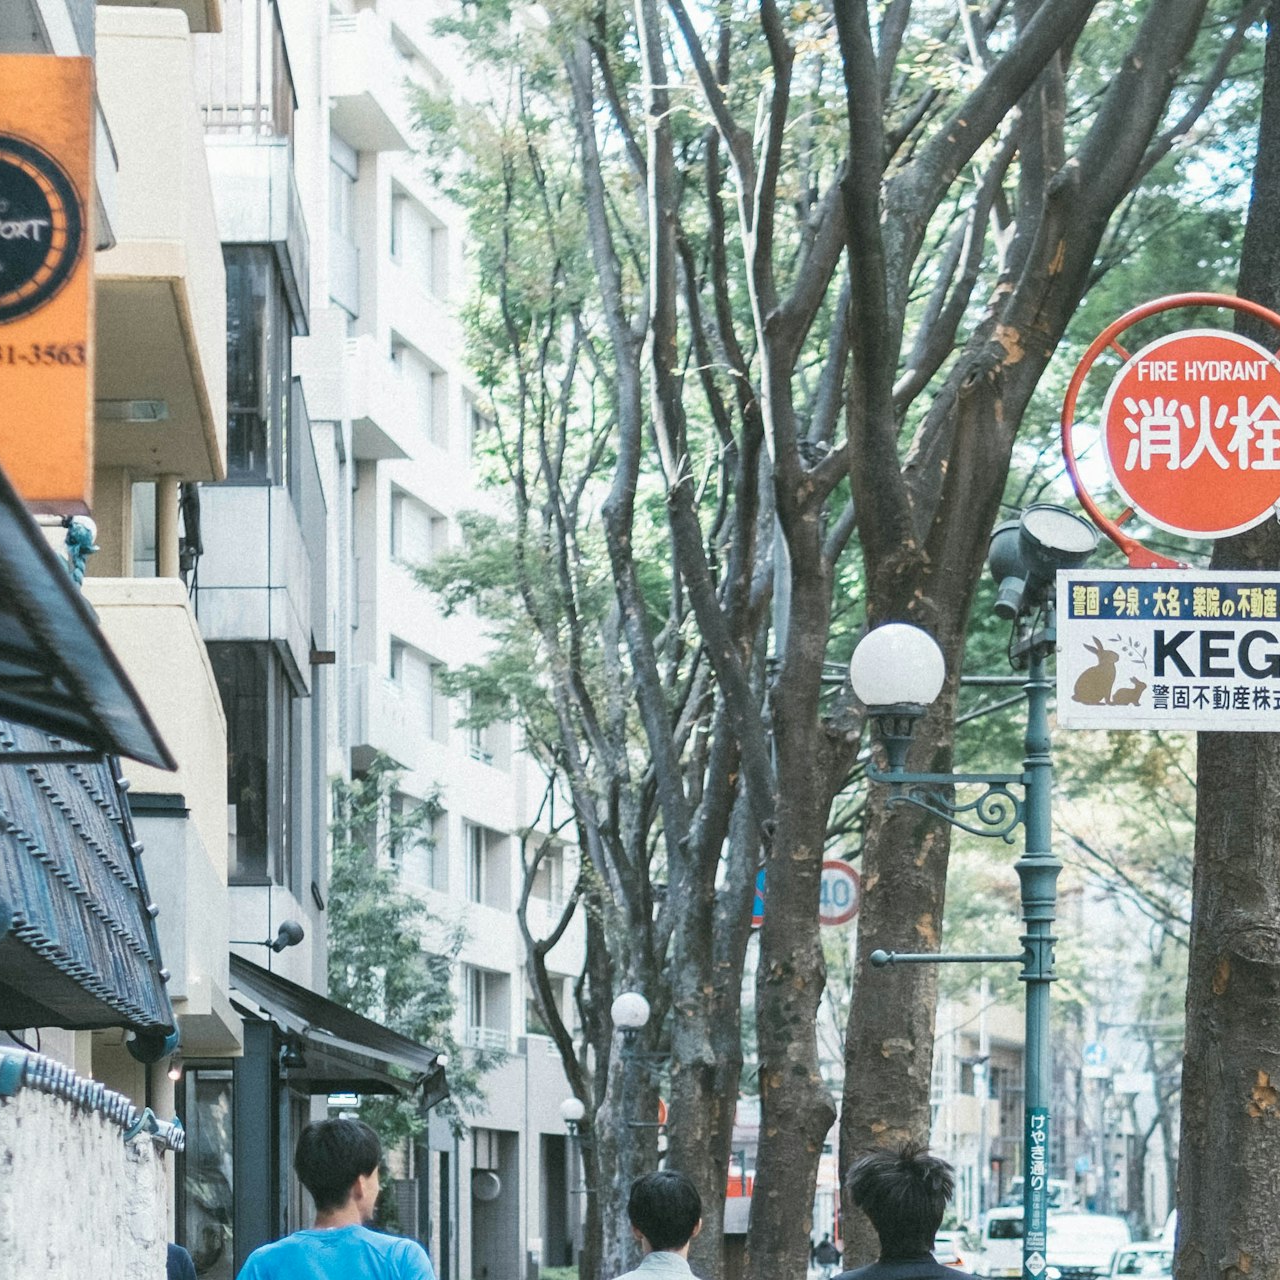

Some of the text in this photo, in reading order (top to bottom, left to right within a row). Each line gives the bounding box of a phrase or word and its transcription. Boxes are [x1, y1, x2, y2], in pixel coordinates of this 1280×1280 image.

[1137, 360, 1270, 382] FIRE HYDRANT
[1030, 1114, 1046, 1191] けやき通り
